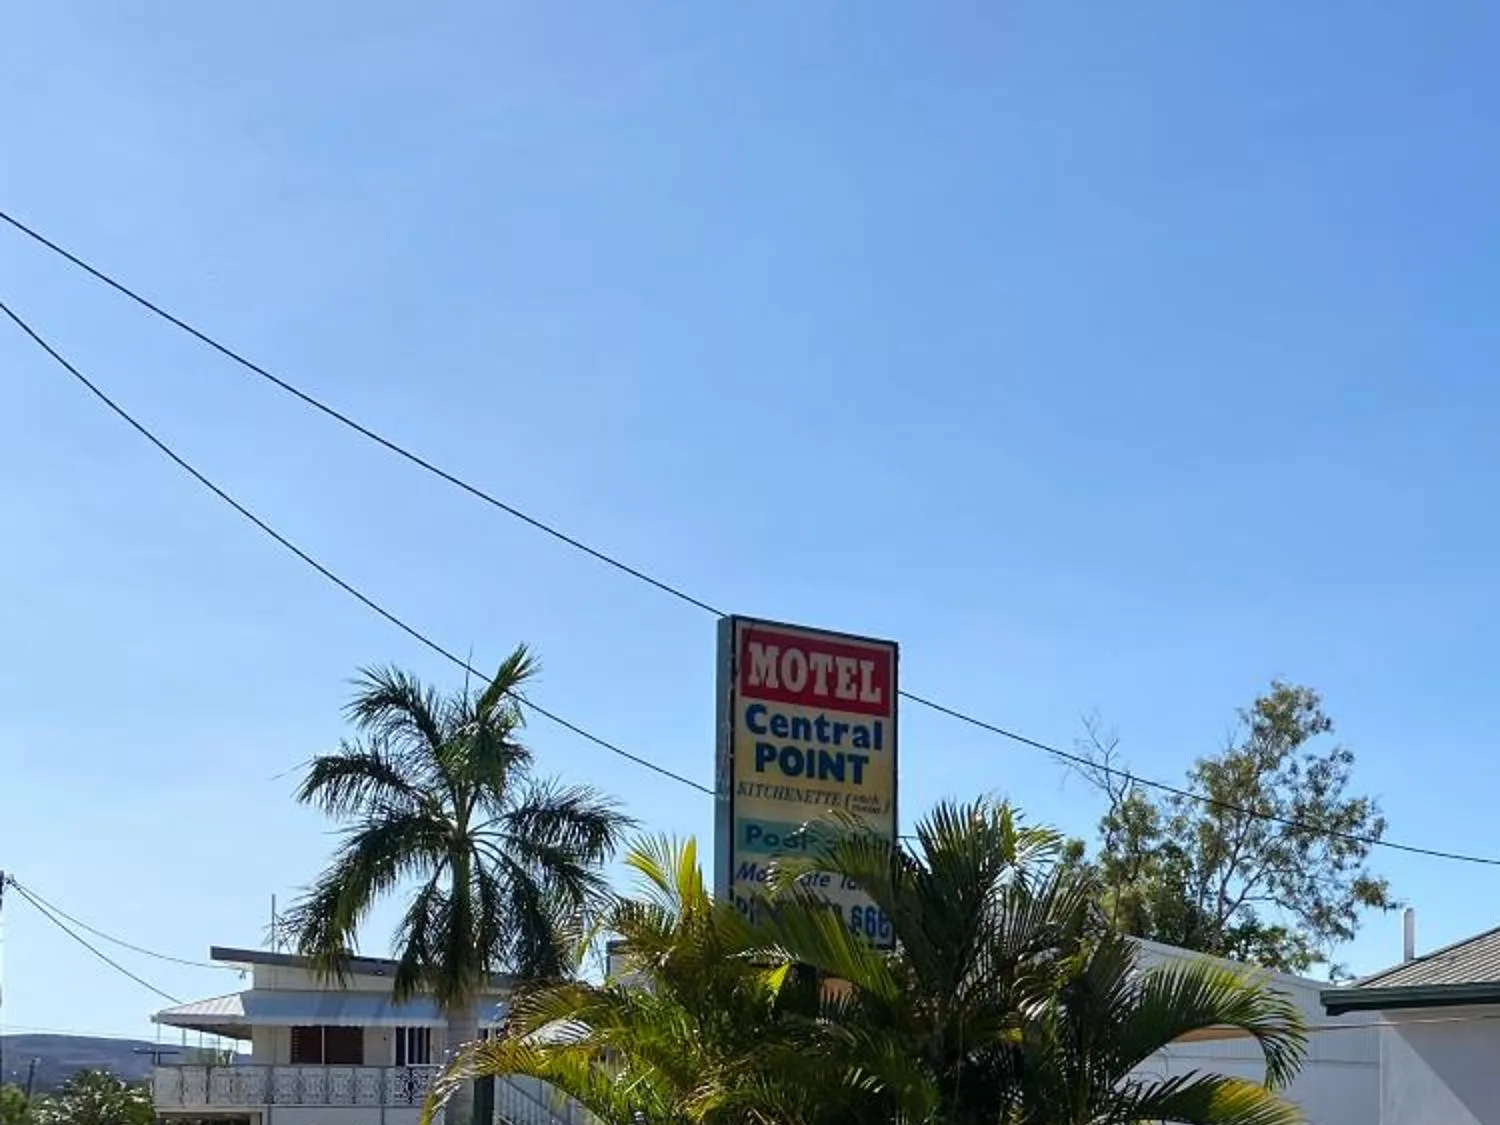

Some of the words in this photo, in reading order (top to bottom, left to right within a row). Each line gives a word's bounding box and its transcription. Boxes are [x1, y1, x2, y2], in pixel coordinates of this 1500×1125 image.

[749, 641, 881, 704] MOTEL
[745, 703, 882, 751] Central
[755, 742, 869, 785] POINT
